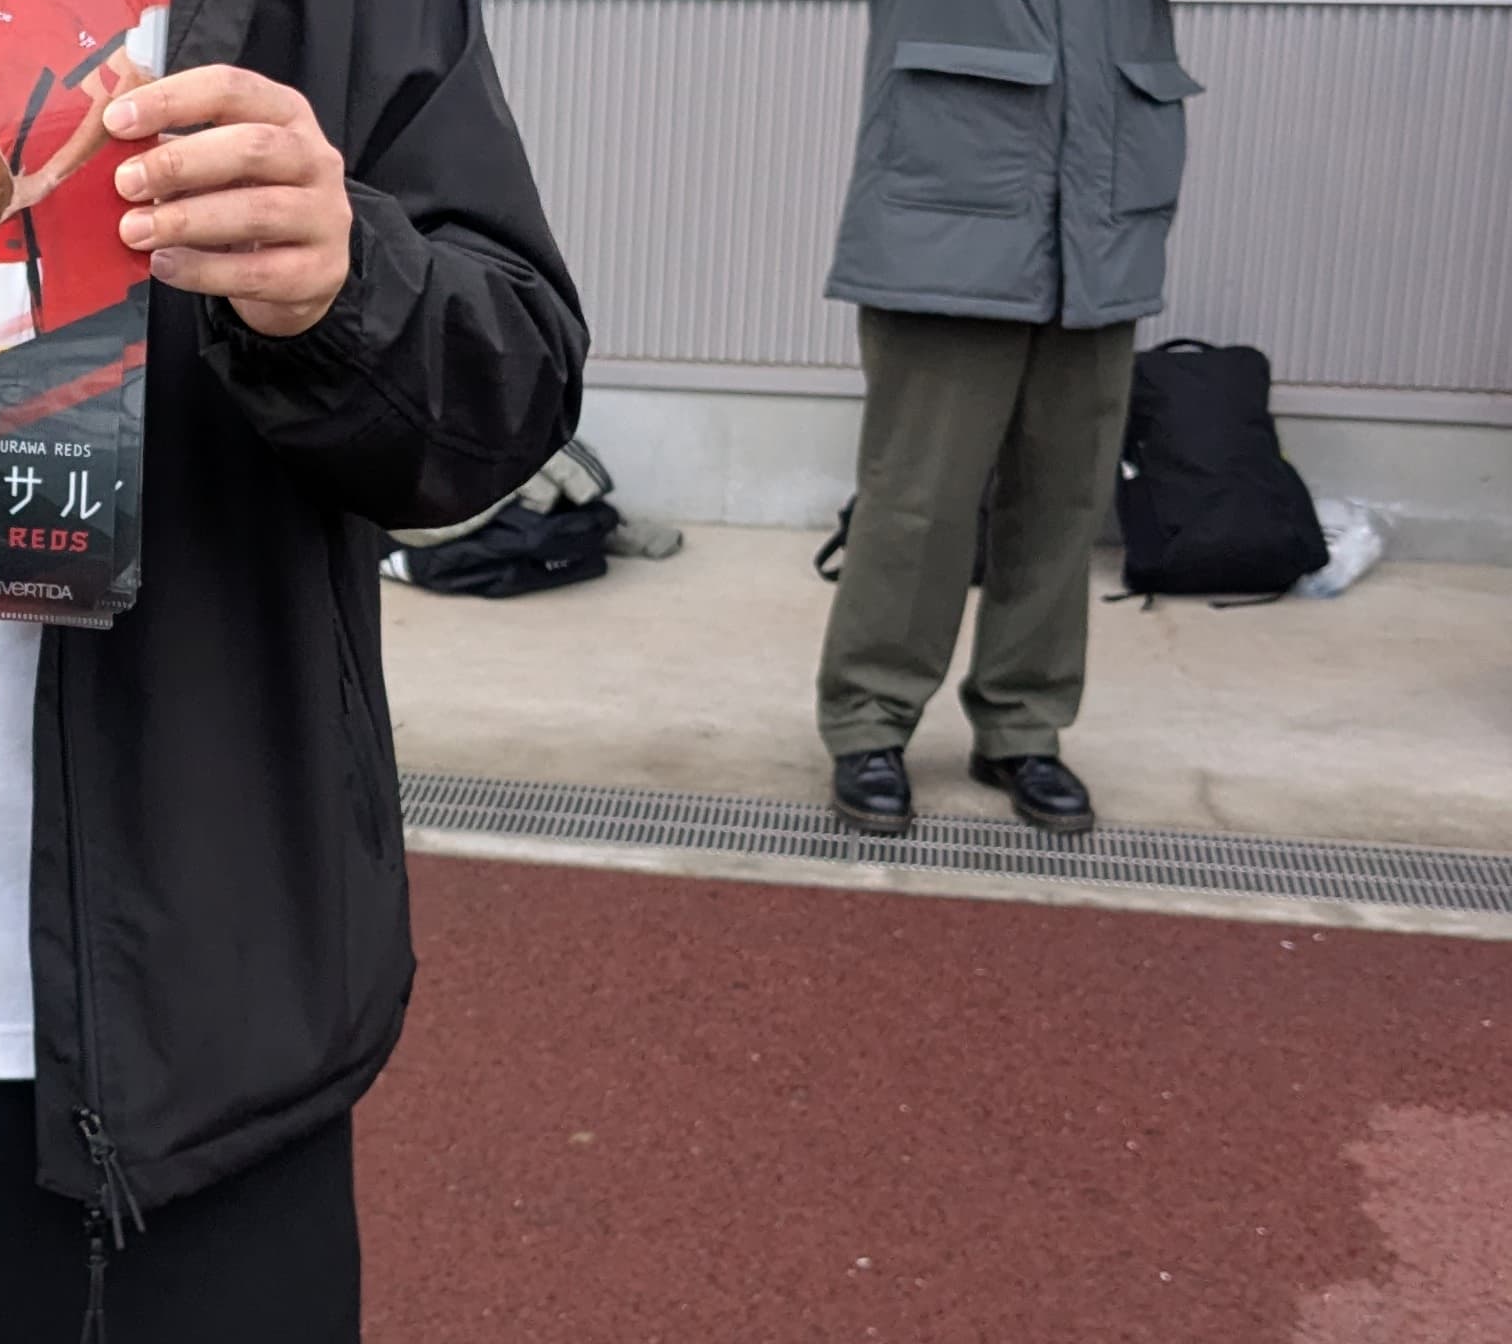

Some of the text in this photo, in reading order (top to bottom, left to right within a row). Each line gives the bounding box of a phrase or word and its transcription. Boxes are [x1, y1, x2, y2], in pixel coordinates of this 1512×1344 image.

[0, 440, 47, 456] URAWA
[54, 442, 92, 458] REDS
[8, 525, 89, 553] REDS
